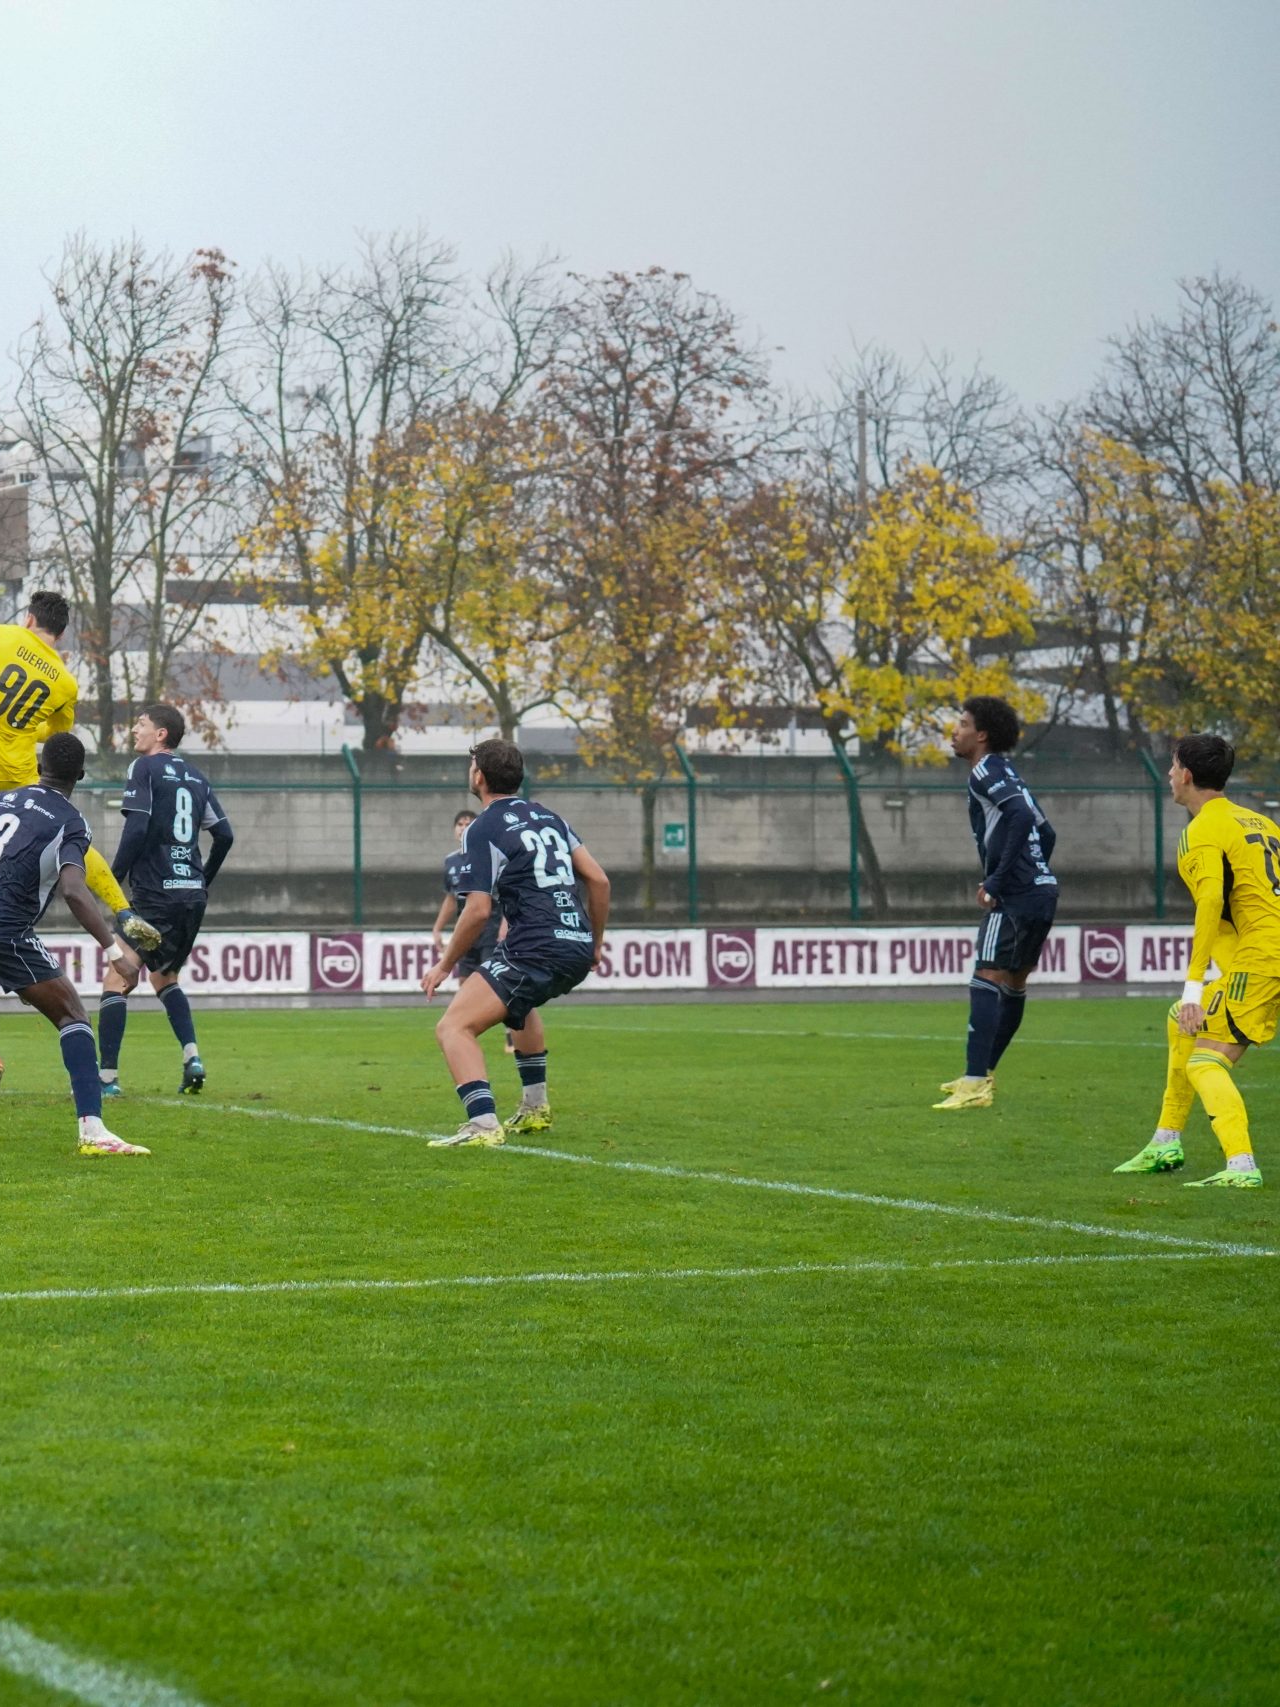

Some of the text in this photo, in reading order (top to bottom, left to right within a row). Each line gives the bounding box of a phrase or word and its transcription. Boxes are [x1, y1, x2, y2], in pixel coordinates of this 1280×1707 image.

[16, 645, 60, 683] GUERRISI
[173, 787, 193, 842] 8
[520, 826, 575, 888] 23
[596, 941, 692, 978] S.COM
[771, 940, 878, 975] AFFETTI
